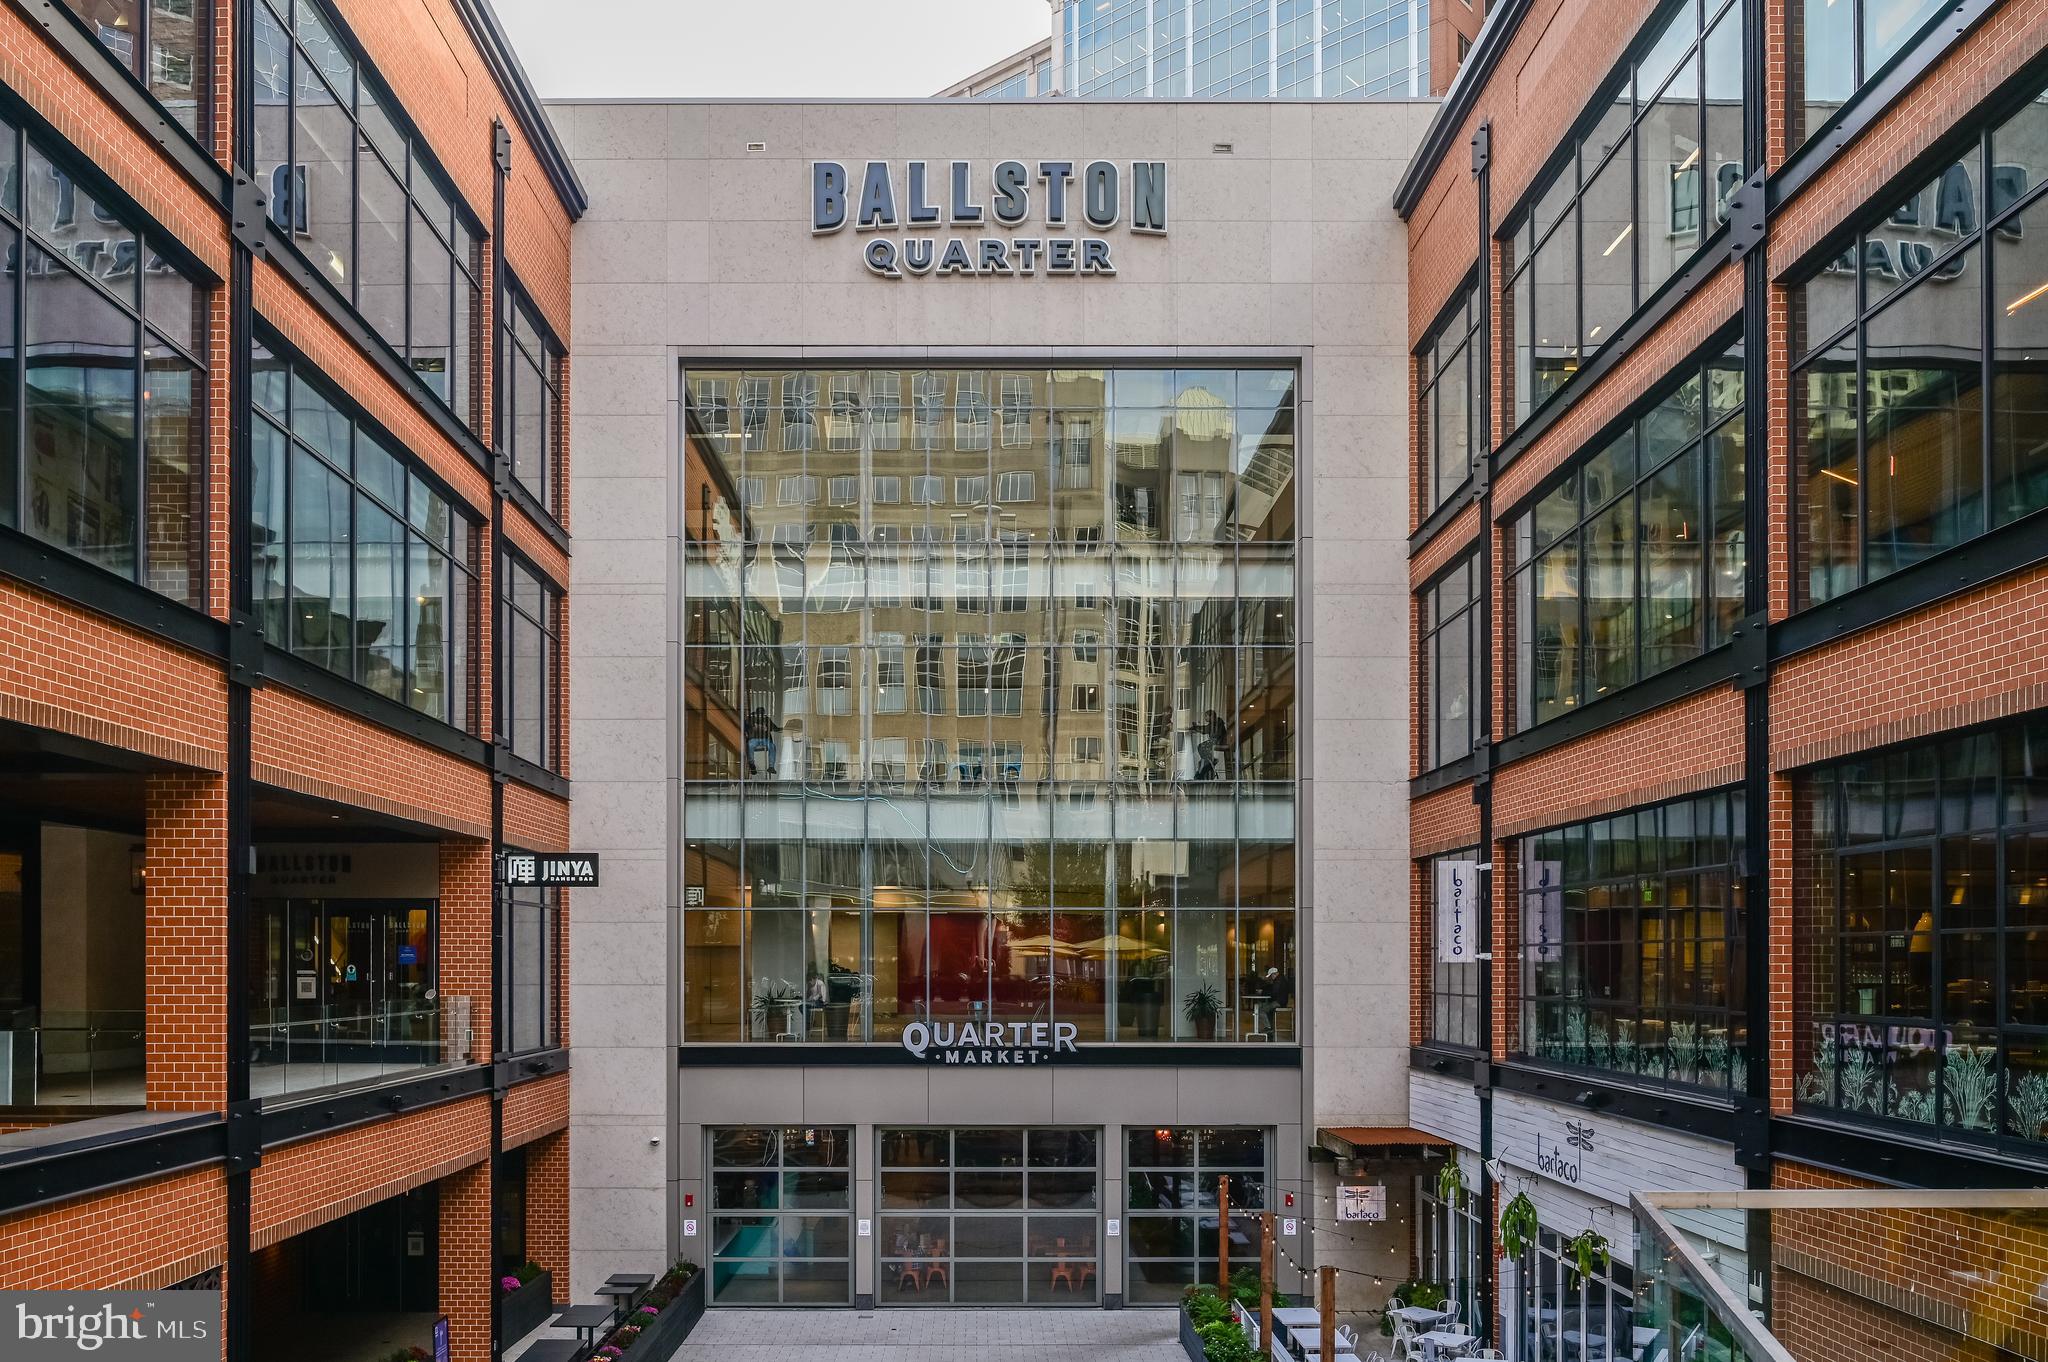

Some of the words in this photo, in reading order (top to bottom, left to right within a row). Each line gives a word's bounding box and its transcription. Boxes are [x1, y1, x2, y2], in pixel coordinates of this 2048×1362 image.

[811, 160, 1168, 237] BALLSTON
[863, 238, 1118, 280] QUARTER
[541, 860, 594, 881] JINYA
[1452, 868, 1463, 956] bartaco
[902, 1022, 1078, 1059] QUARTER
[945, 1050, 1039, 1064] MARKET
[1537, 1131, 1578, 1184] bartaco
[1345, 1206, 1380, 1219] bartaco
